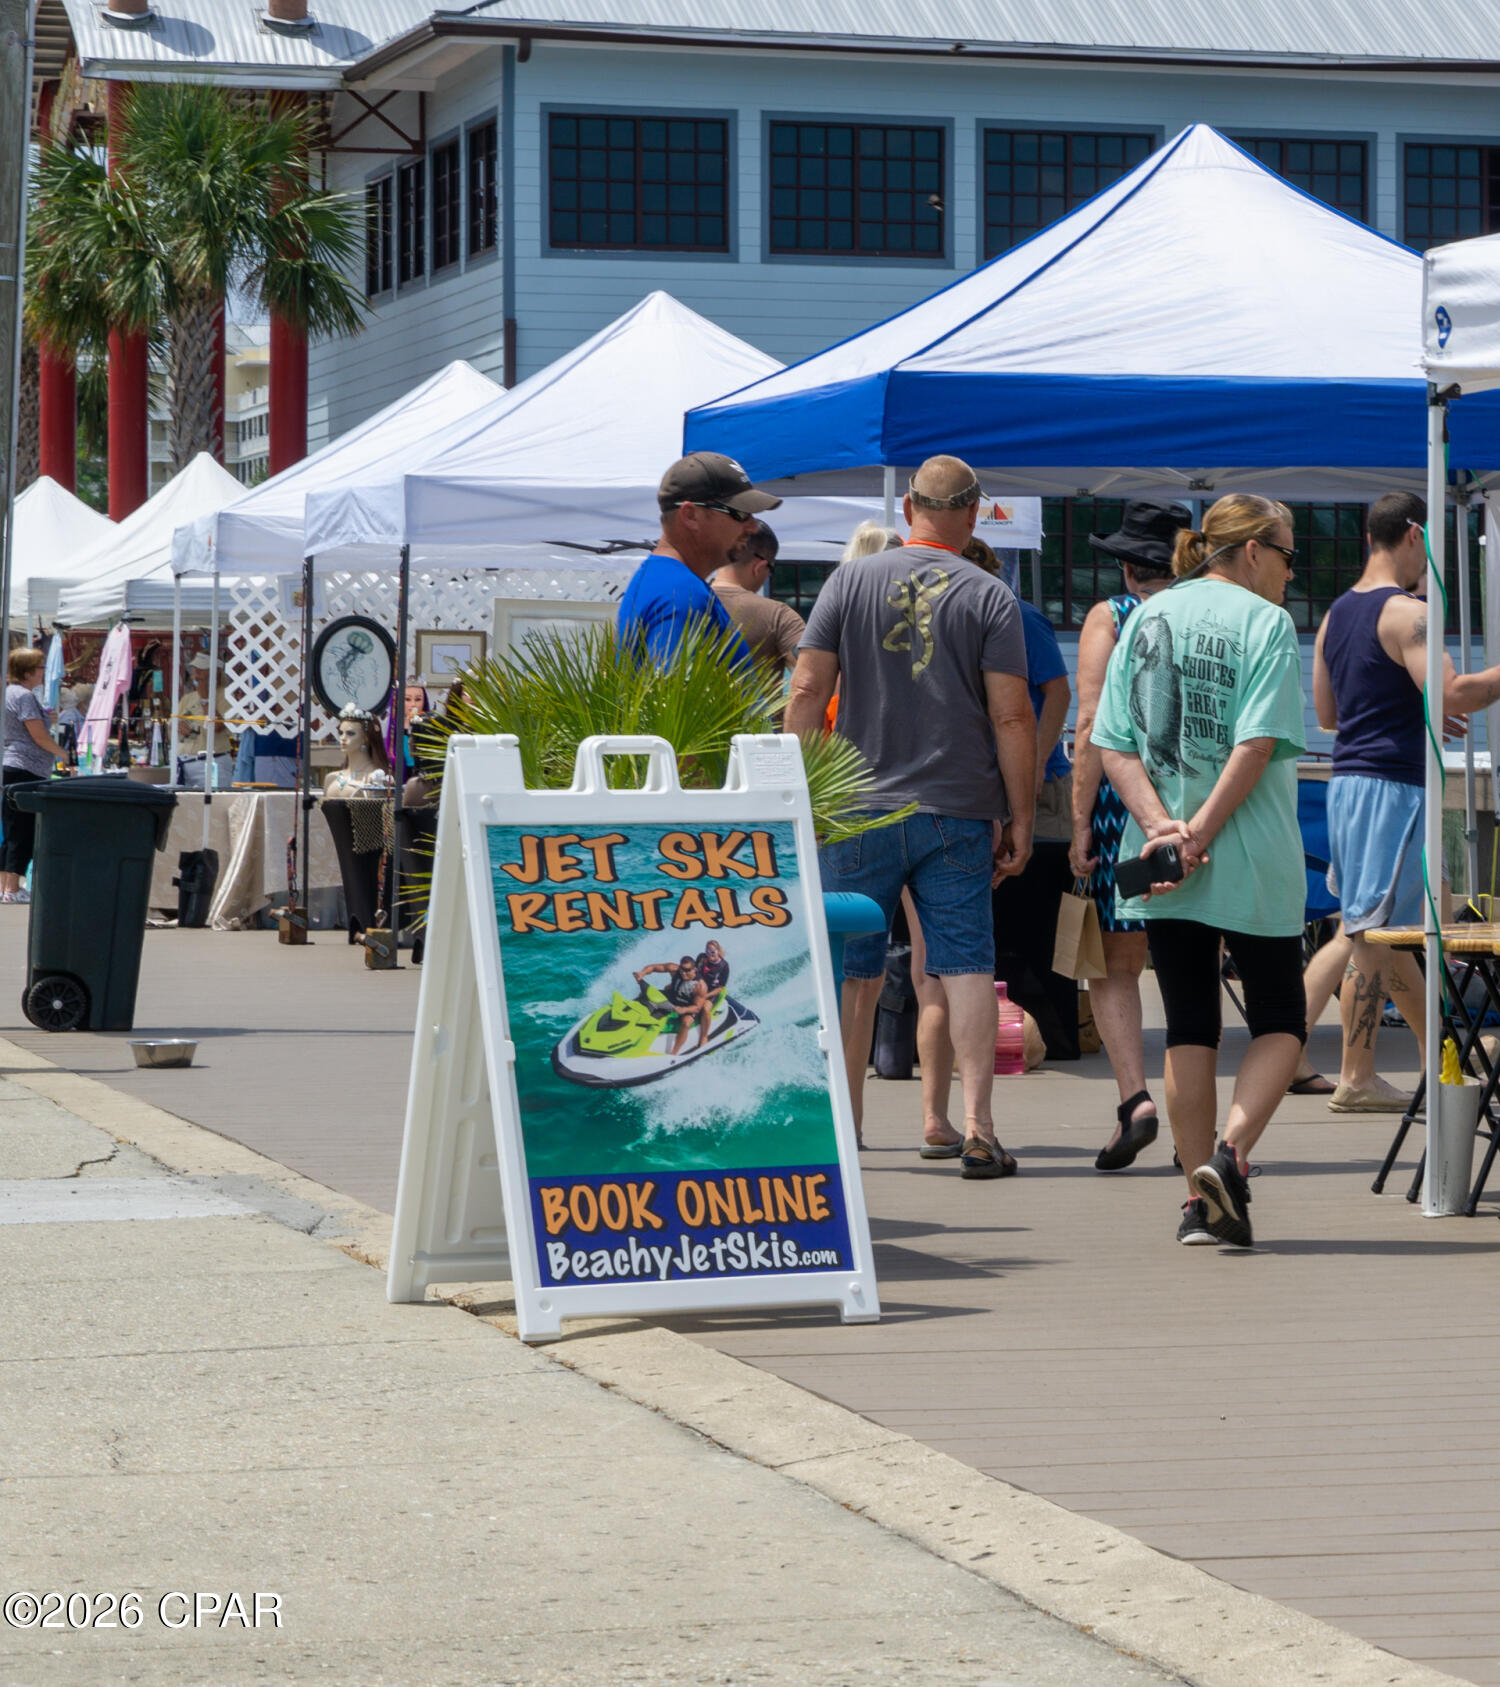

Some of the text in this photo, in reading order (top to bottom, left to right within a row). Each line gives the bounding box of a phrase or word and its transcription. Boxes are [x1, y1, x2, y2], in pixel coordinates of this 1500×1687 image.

[1195, 633, 1226, 660] BAD
[1182, 655, 1236, 689] CHOICES
[1187, 691, 1226, 720] GREAT
[500, 831, 779, 884] JET SKI
[506, 886, 792, 933] RENTALS
[540, 1173, 832, 1236] BOOK ONLINE
[546, 1231, 839, 1280] BeachyJetSkis.com
